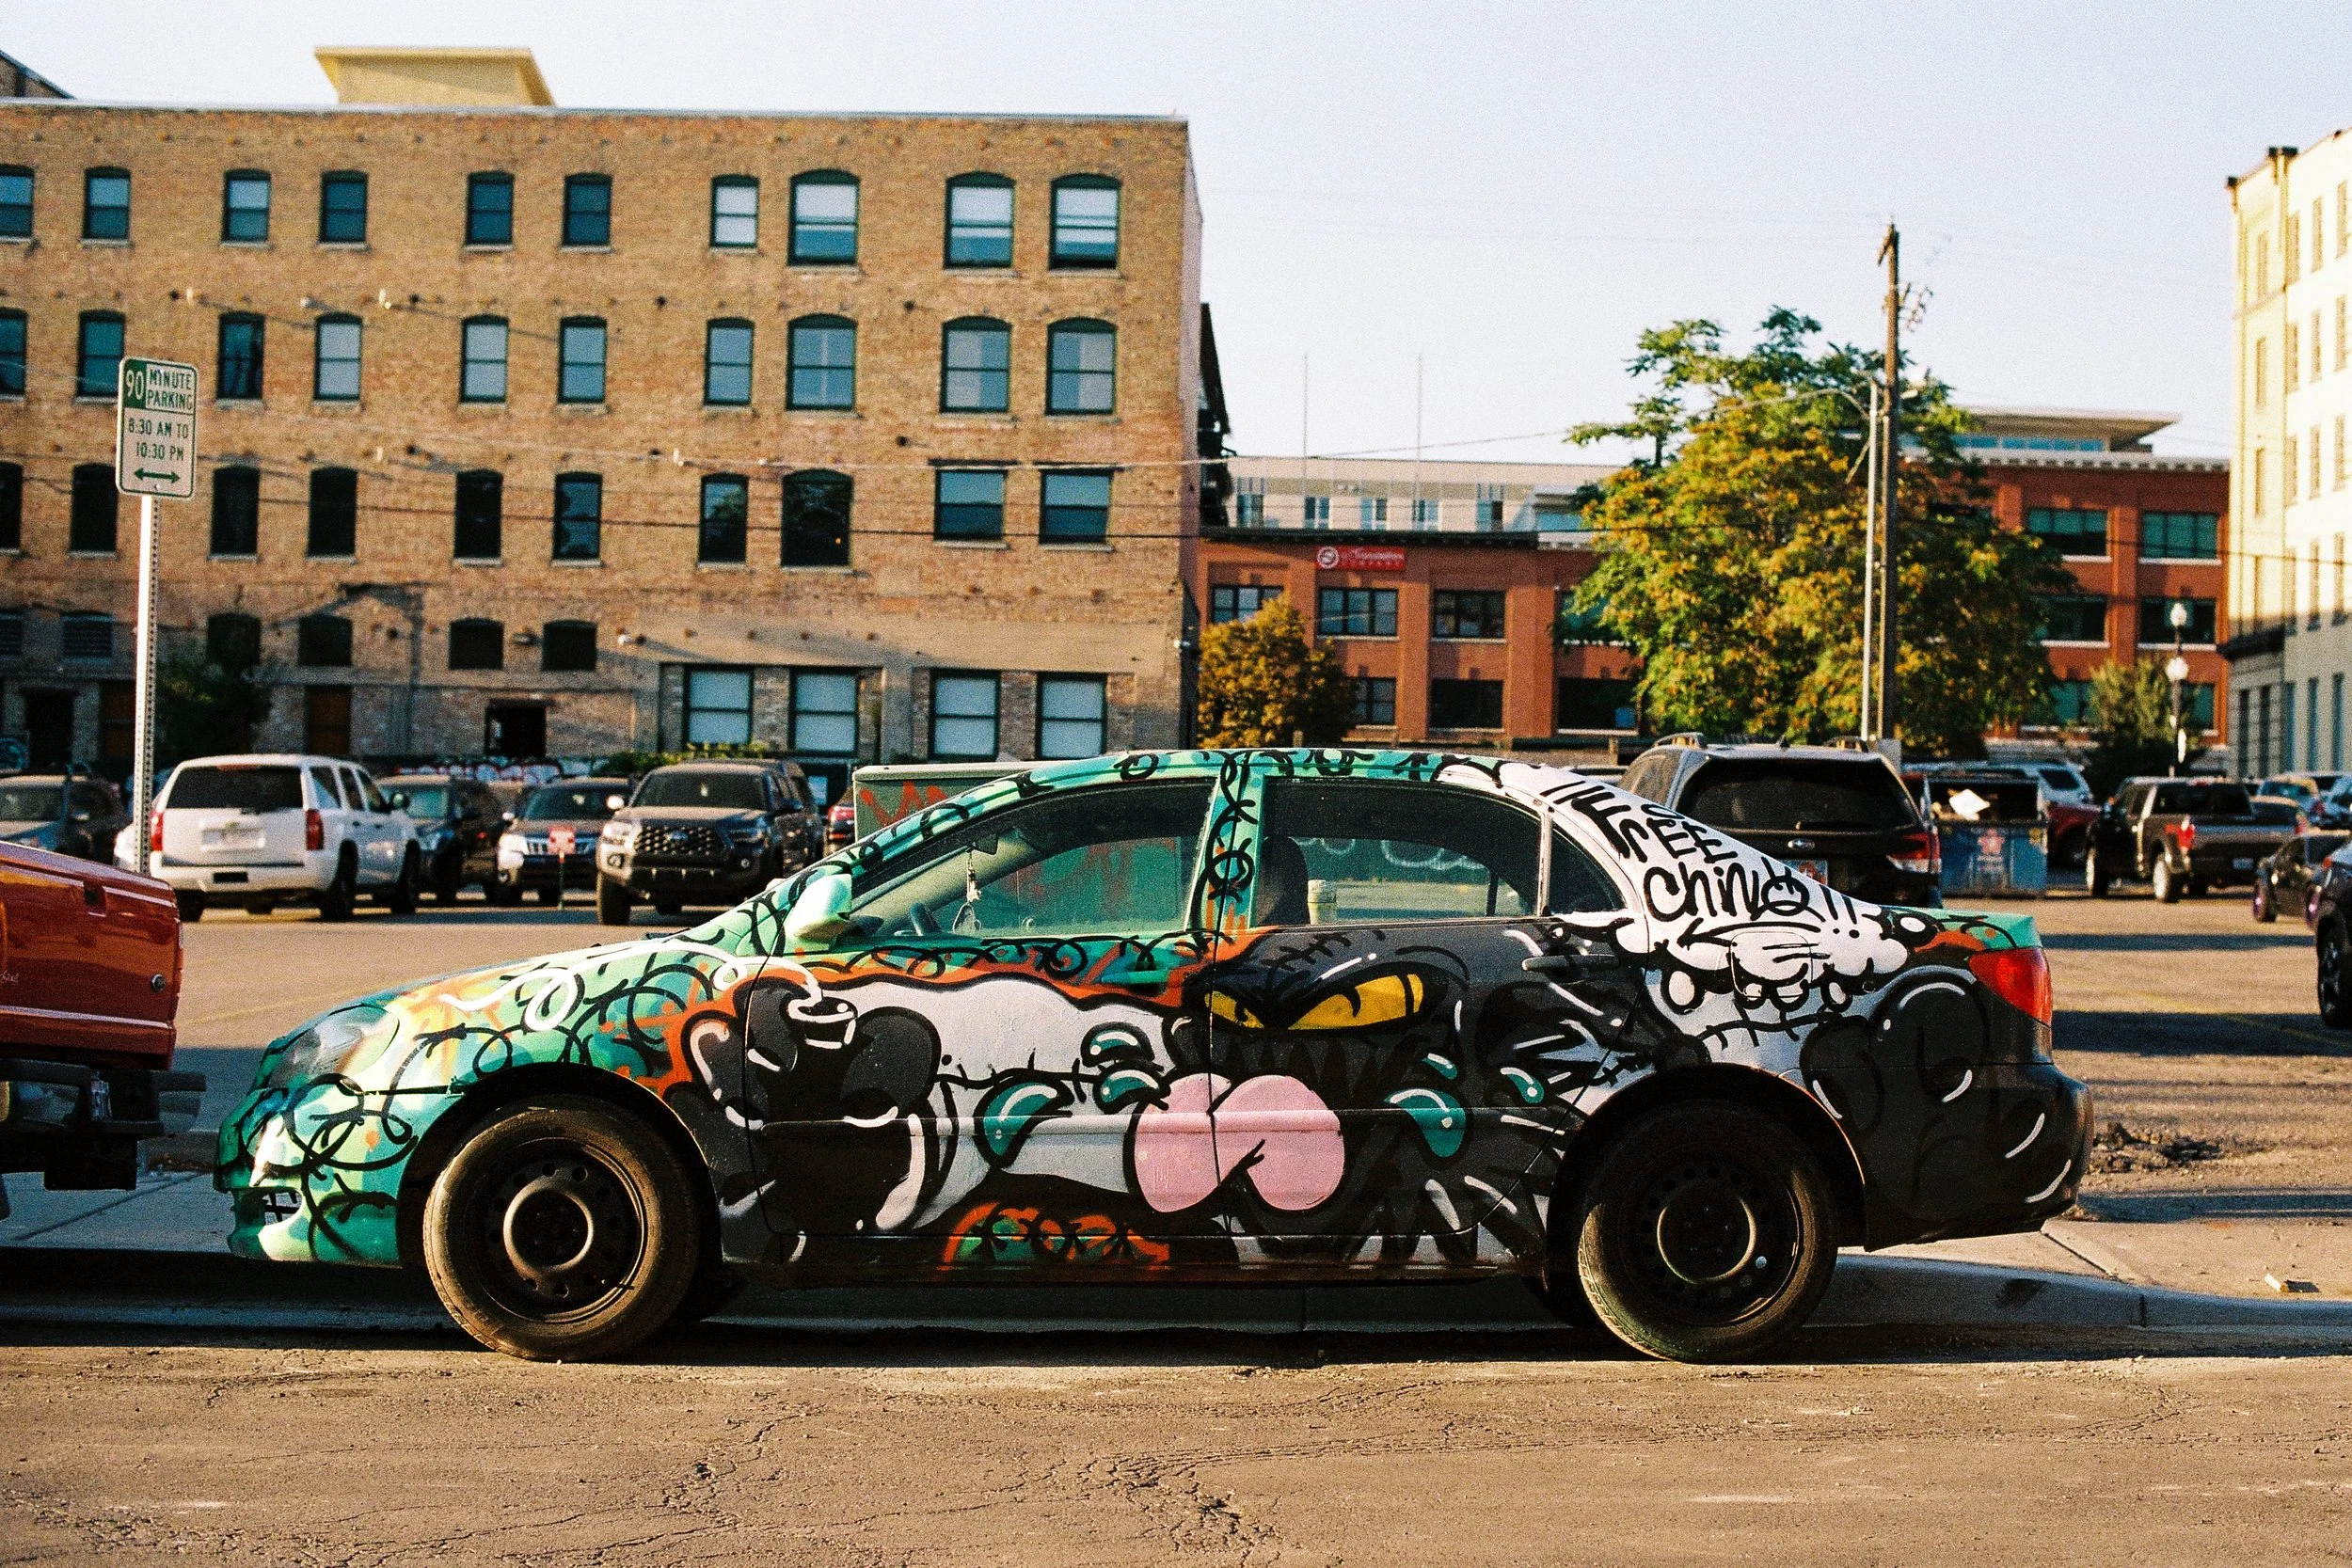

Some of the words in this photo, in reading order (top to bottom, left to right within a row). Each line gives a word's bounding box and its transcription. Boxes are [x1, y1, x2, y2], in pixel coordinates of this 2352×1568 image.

[126, 369, 145, 401] 90
[149, 369, 192, 390] MINUTE
[147, 389, 193, 411] PARKING
[128, 418, 152, 436] 8:30
[156, 420, 172, 436] AM
[176, 423, 189, 439] TO
[135, 442, 166, 460] 10:30
[169, 446, 184, 461] PM
